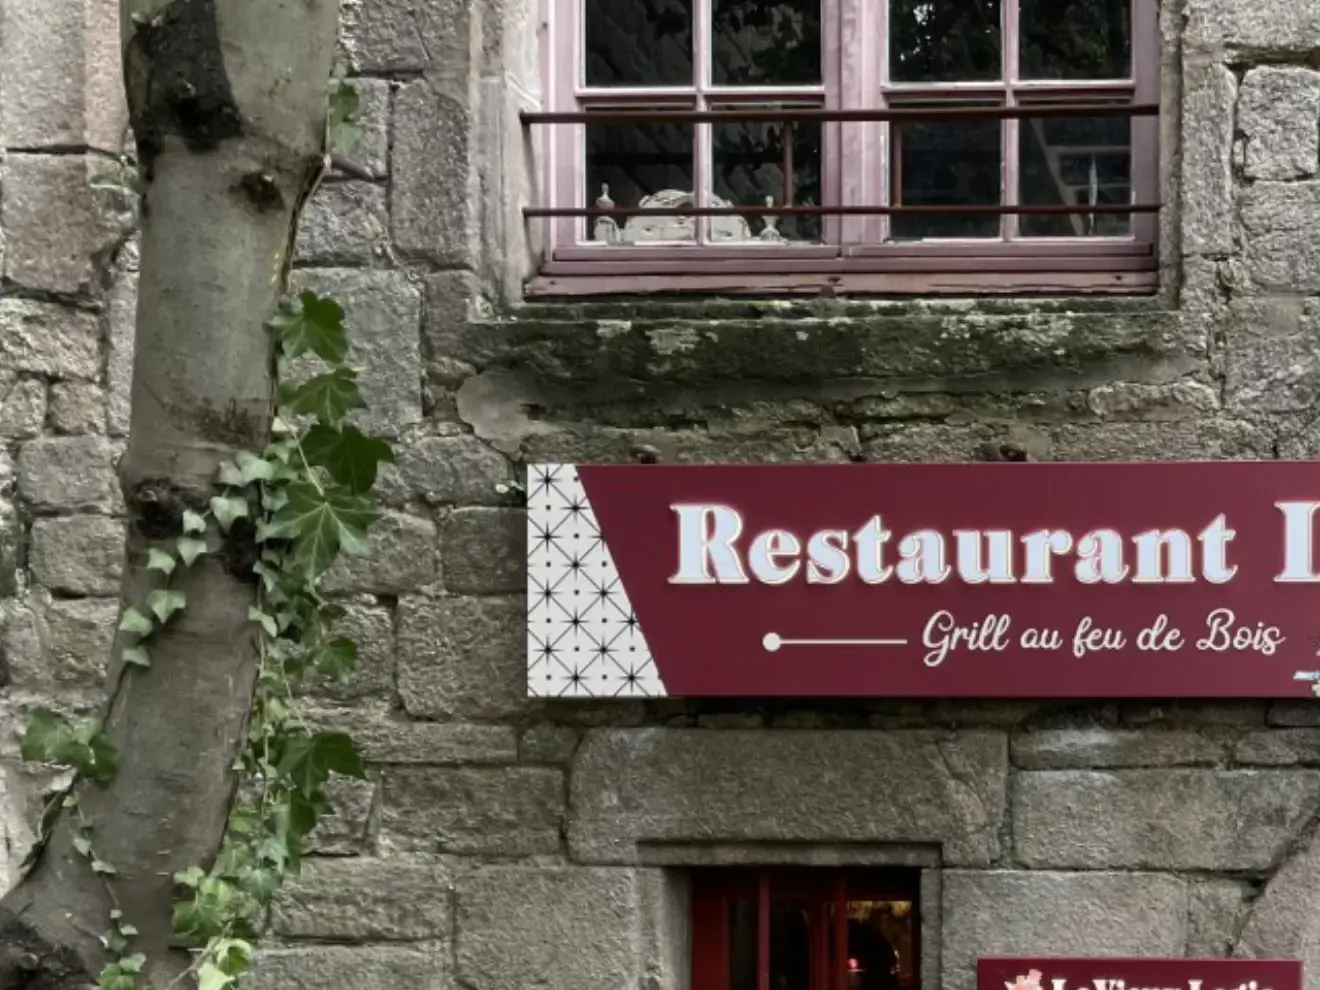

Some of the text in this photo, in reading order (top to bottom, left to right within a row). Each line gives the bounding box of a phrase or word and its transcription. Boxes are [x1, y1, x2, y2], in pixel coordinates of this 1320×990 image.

[669, 502, 1238, 584] Restaurant
[921, 607, 1287, 668] Grill au feu de Bois
